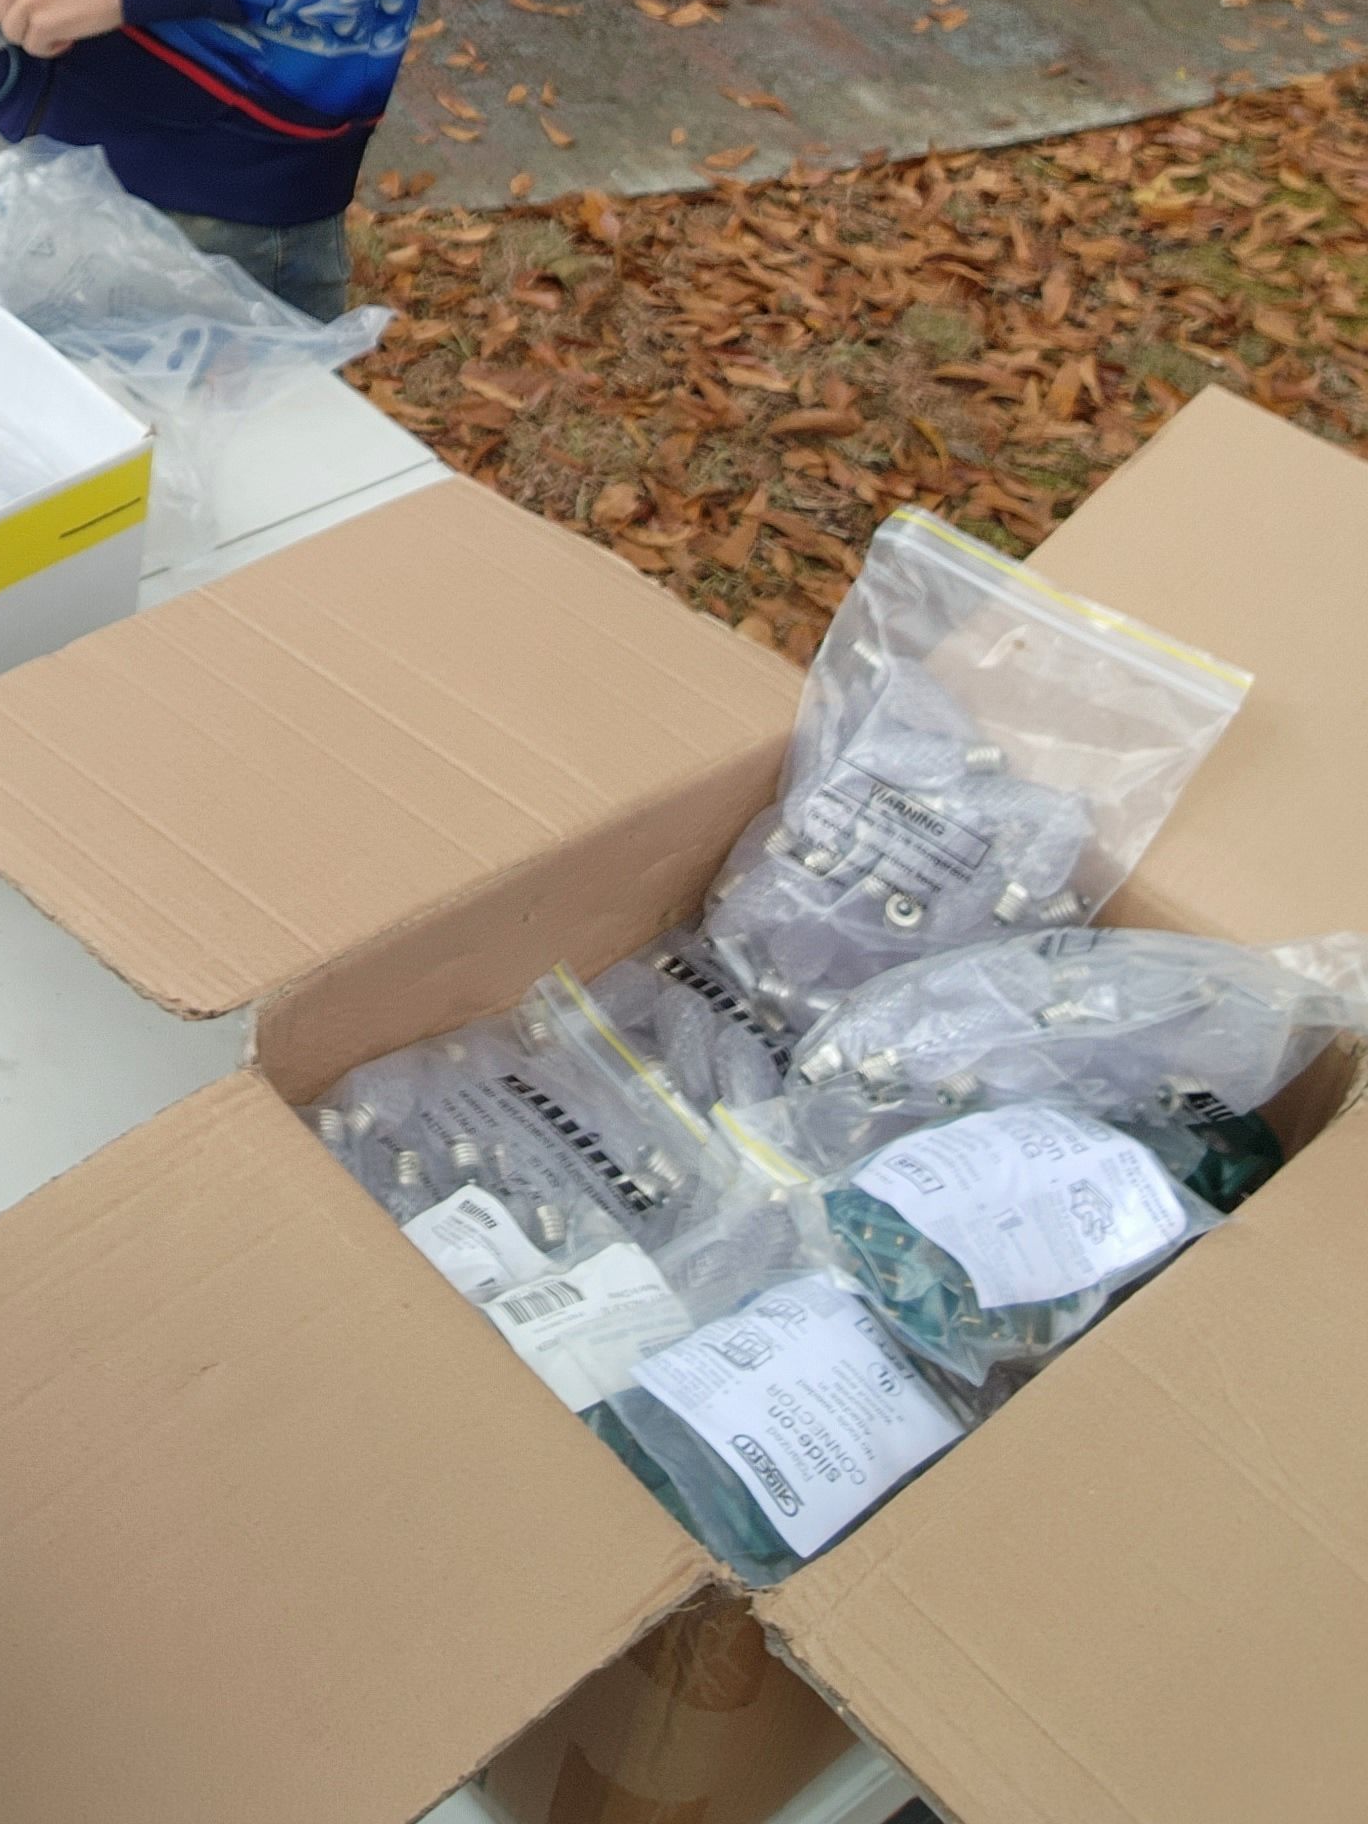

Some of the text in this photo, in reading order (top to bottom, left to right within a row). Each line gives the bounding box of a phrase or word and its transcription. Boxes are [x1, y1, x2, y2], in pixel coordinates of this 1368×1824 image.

[870, 781, 947, 839] WARNING
[730, 1430, 802, 1518] GILBERT
[765, 1380, 867, 1488] CONNECTOR
[765, 1402, 841, 1485] slide-on
